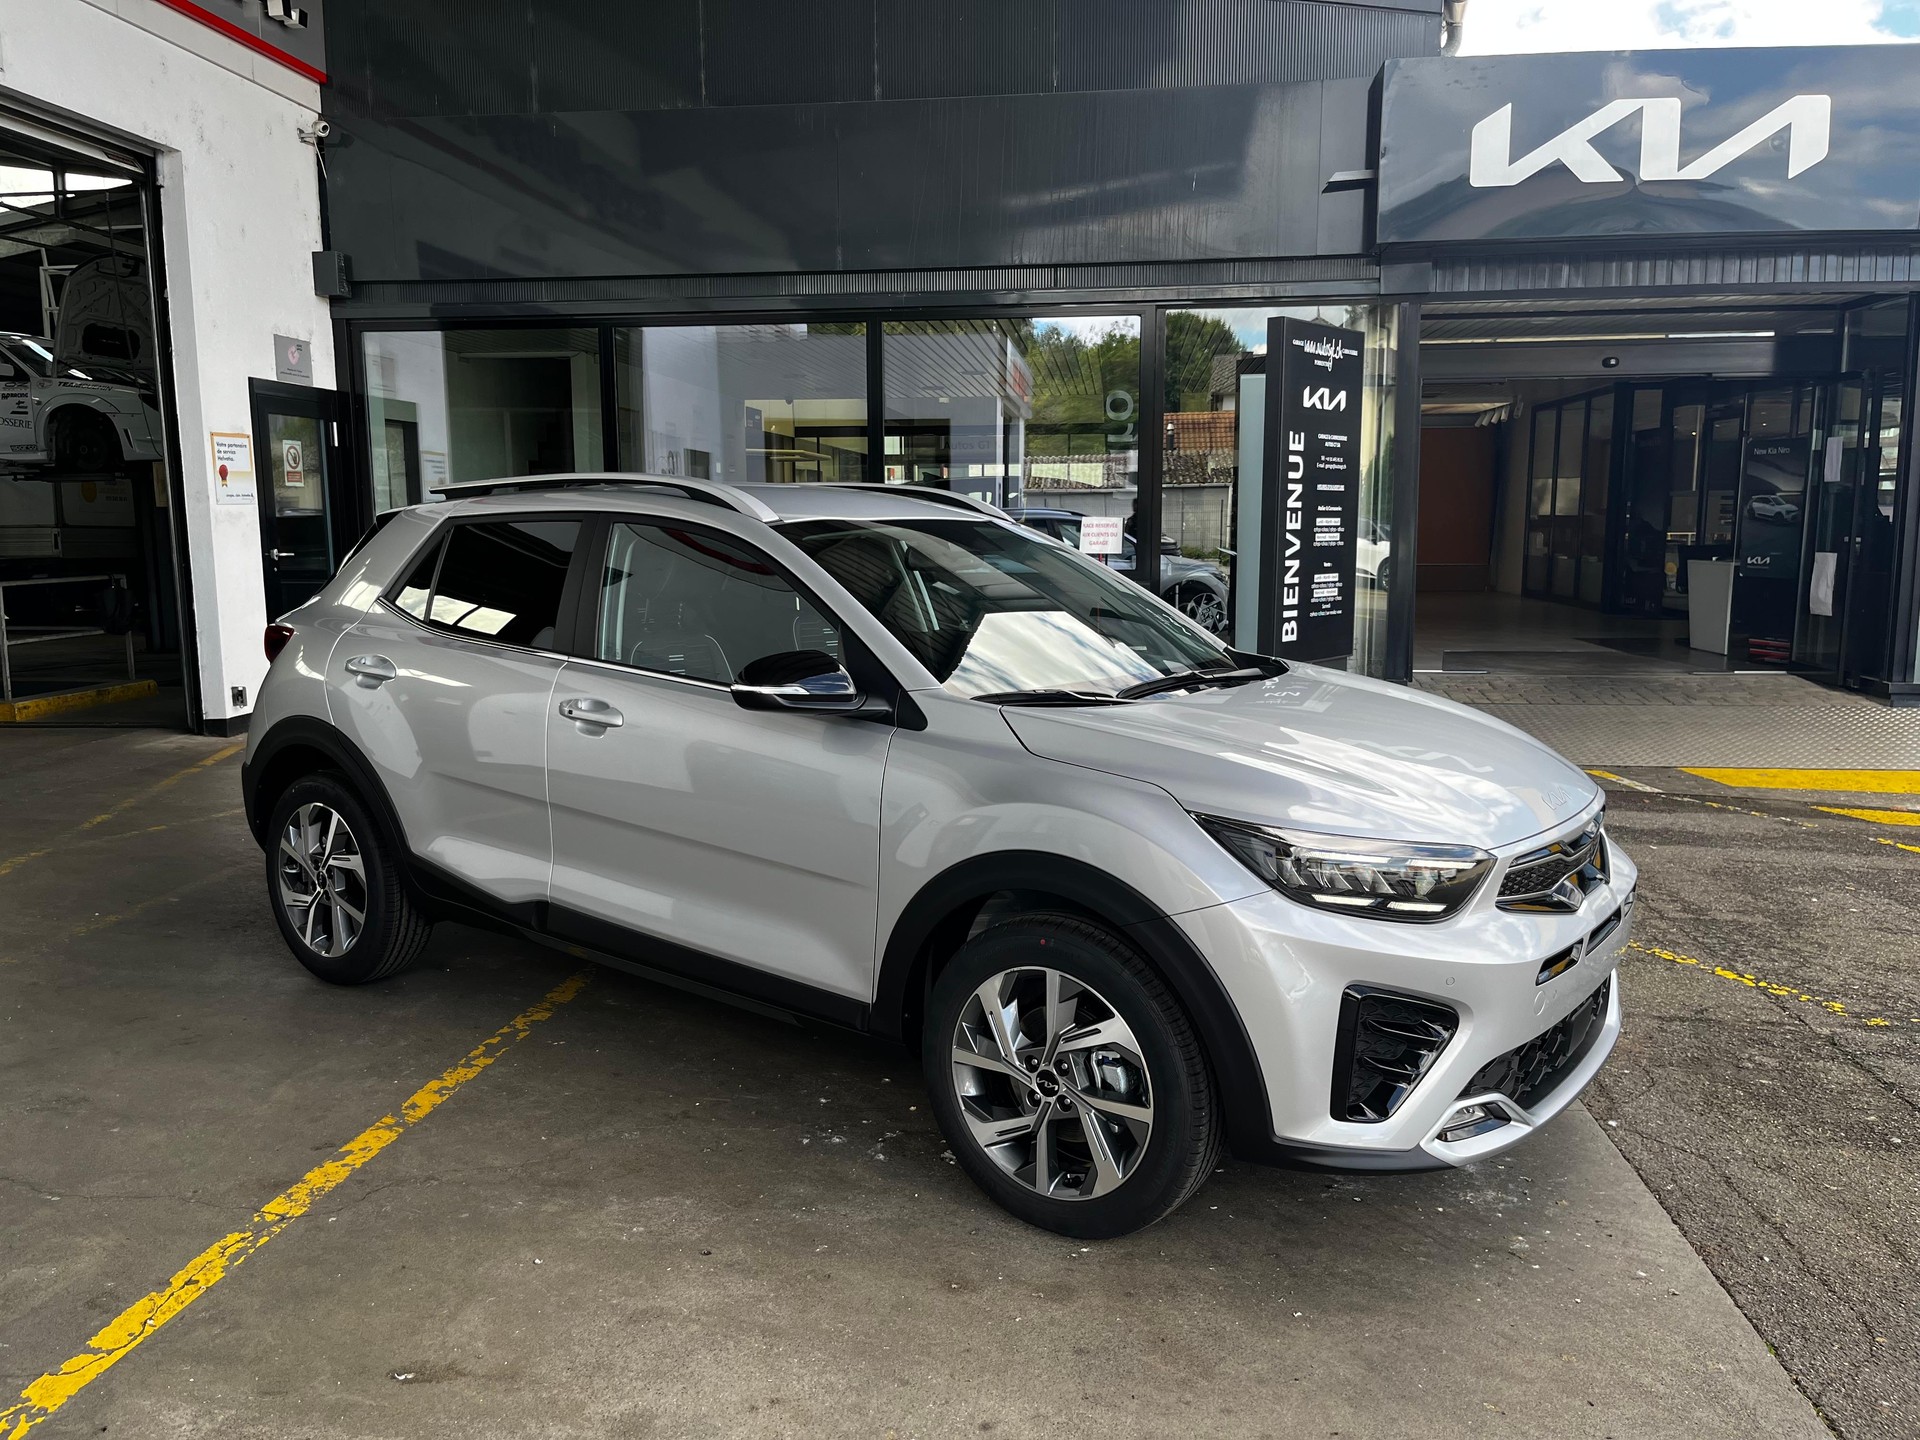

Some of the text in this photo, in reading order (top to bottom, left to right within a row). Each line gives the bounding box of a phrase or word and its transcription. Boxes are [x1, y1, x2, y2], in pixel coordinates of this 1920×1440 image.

[1469, 95, 1831, 187] KIA
[1303, 386, 1346, 411] KIA
[1281, 430, 1305, 642] BIENVENUE
